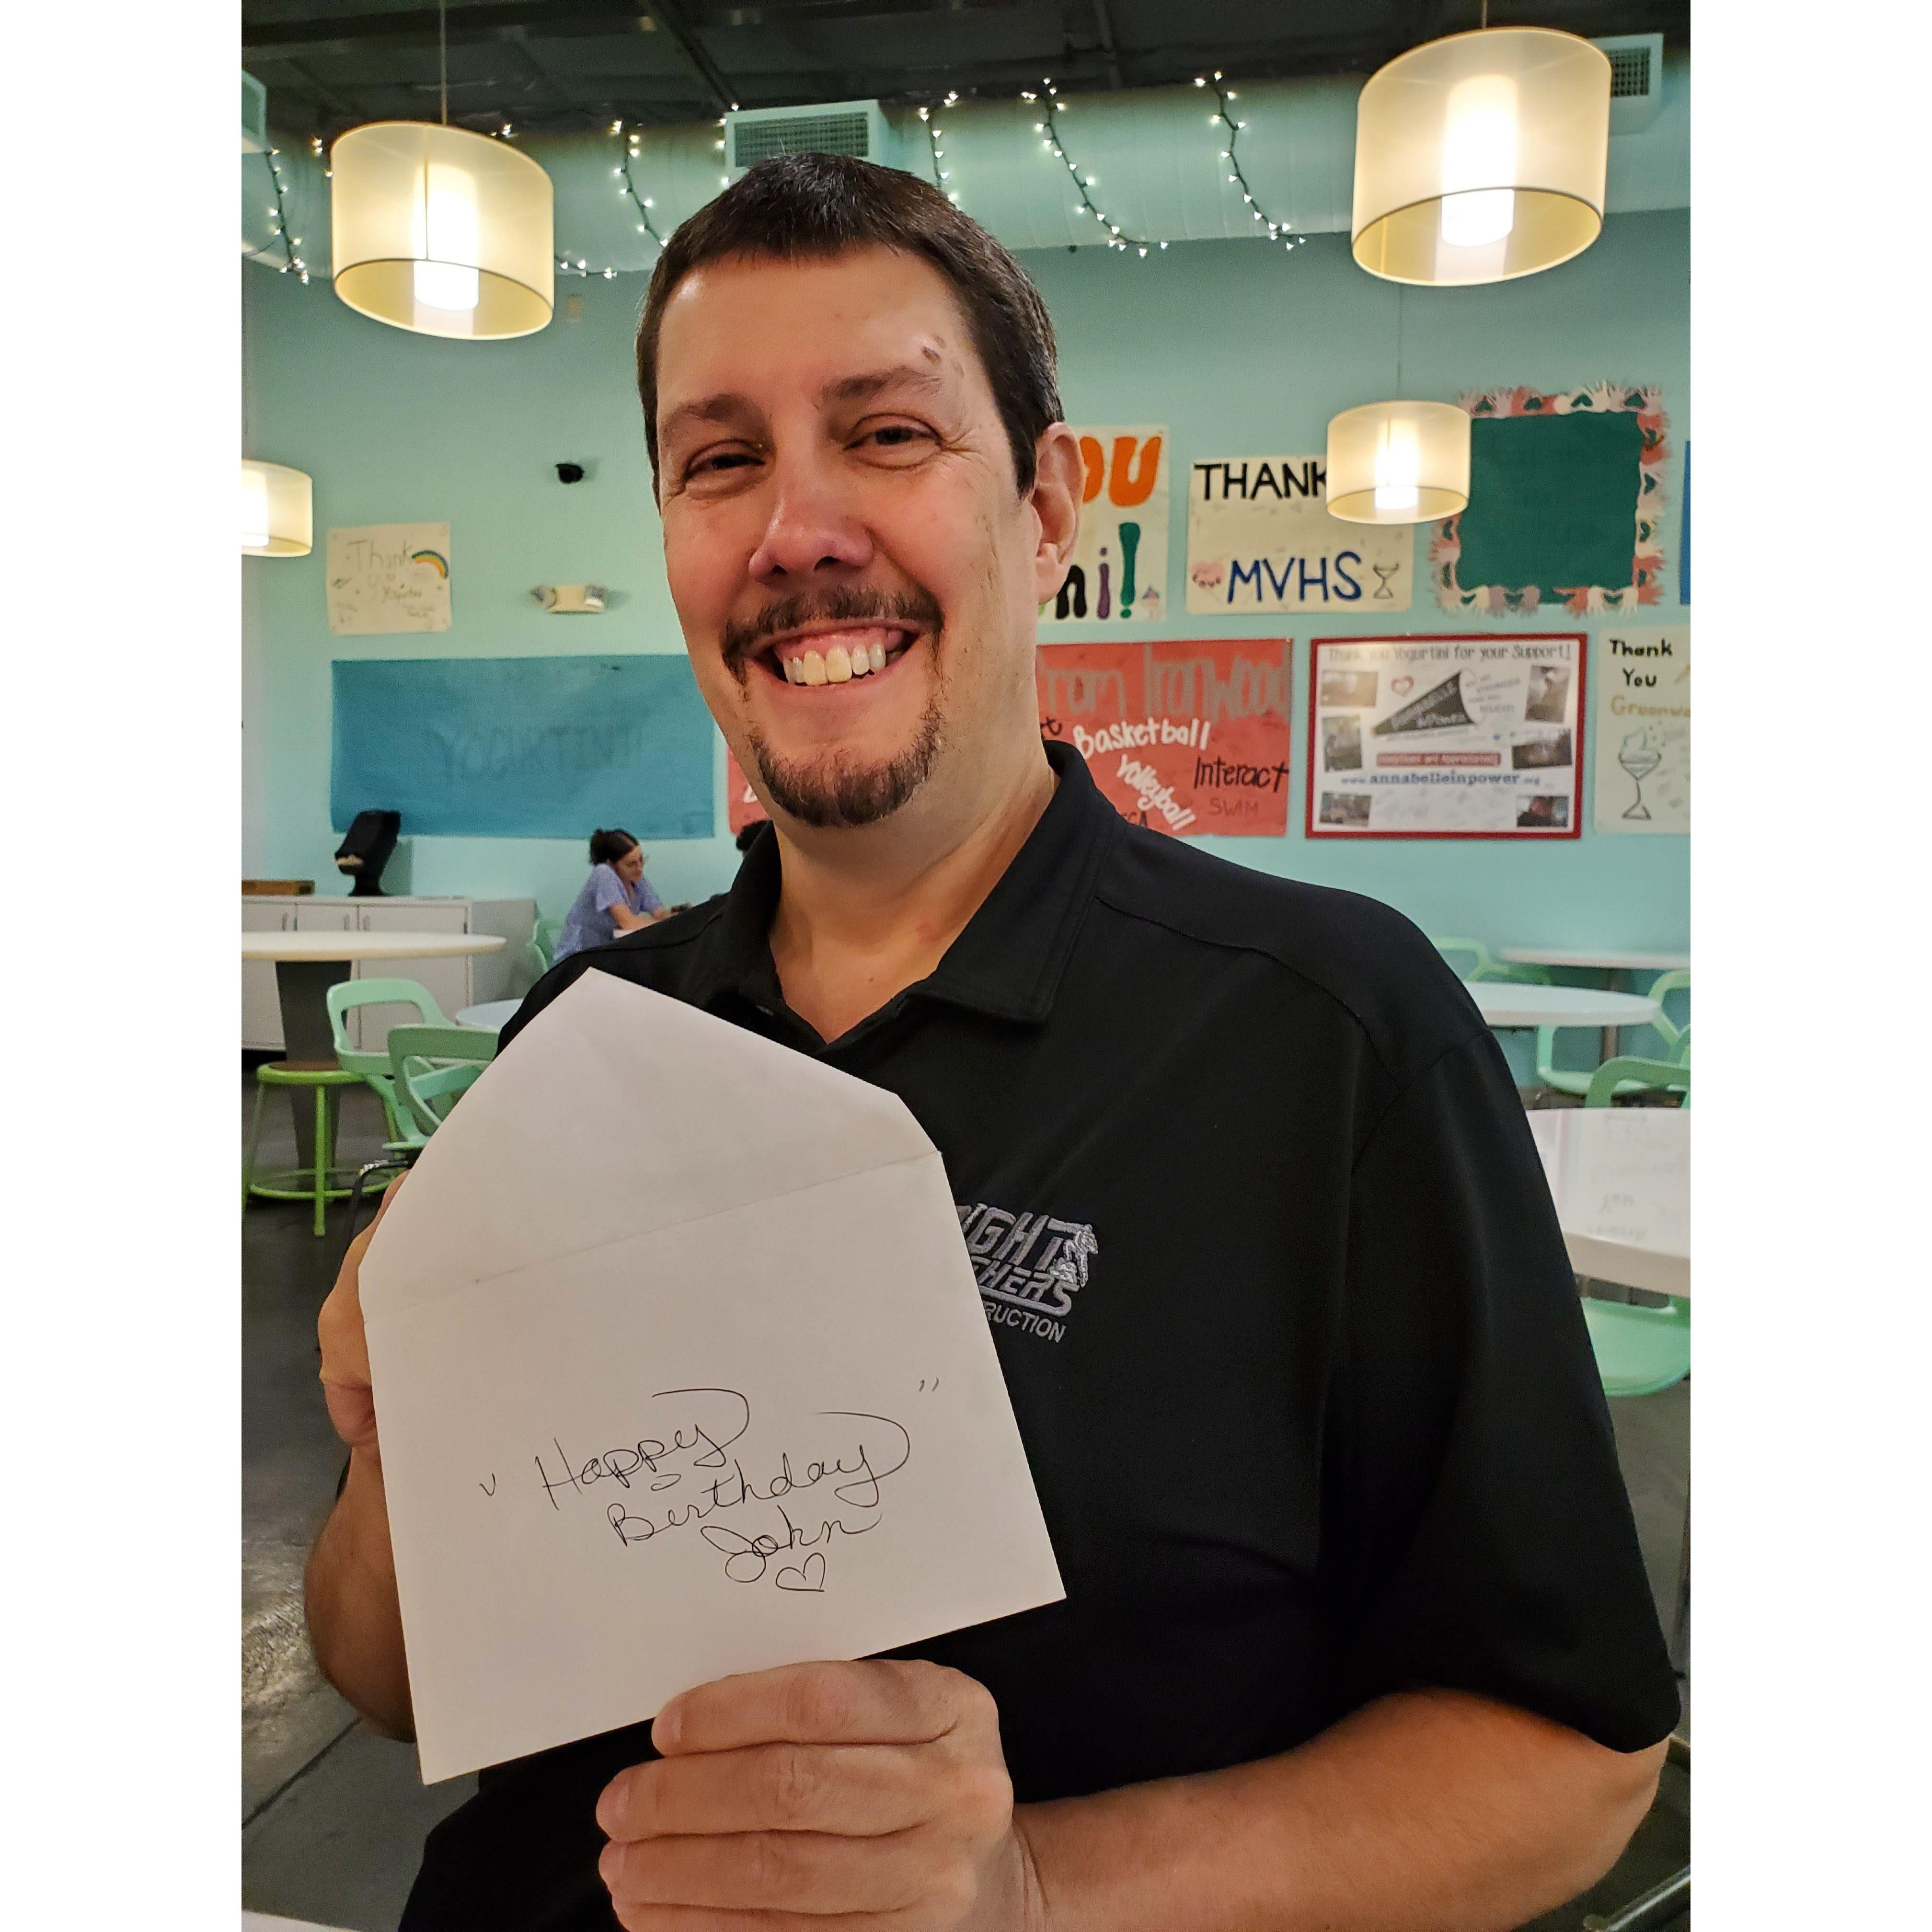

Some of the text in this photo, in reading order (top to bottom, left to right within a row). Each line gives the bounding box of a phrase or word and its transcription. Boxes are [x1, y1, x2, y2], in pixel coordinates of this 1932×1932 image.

[1228, 551, 1362, 603] MVHS
[1454, 644, 1475, 660] for
[1480, 646, 1508, 662] your
[1609, 637, 1673, 657] Thank
[1072, 717, 1211, 760] Basketball
[1194, 756, 1290, 793] Interact
[982, 1300, 1067, 1343] RUCTION
[535, 1388, 749, 1510] Happy
[700, 1505, 883, 1583] John
